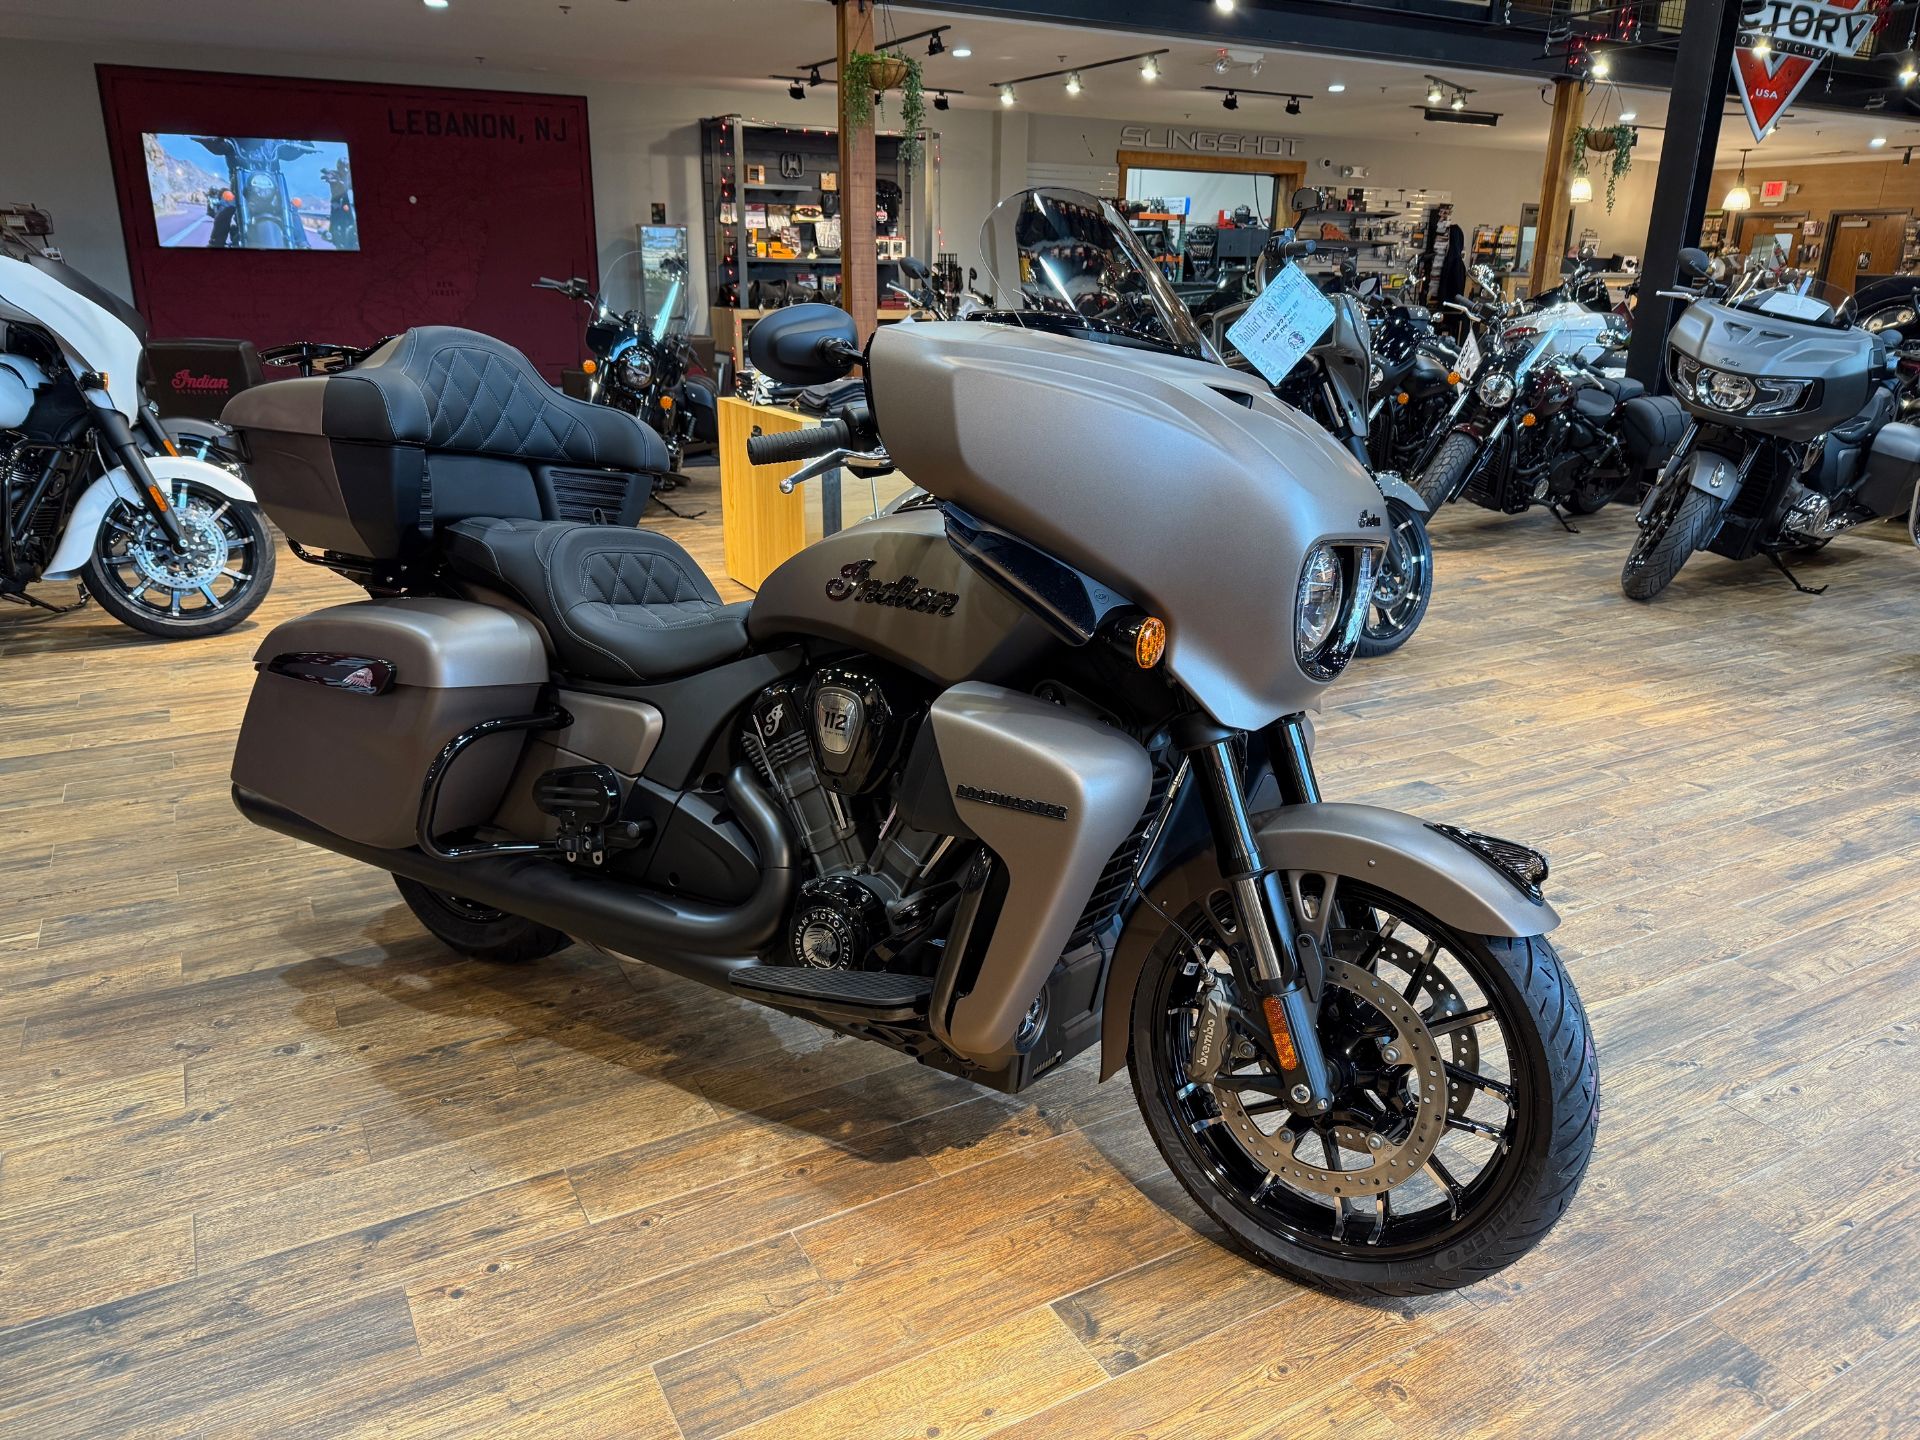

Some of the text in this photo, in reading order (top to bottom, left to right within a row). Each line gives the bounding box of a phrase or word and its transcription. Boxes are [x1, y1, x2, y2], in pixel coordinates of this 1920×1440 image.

[1740, 1, 1867, 48] CTORY
[1755, 88, 1778, 100] USA
[388, 108, 567, 144] LEBANON, NJ
[1120, 126, 1304, 157] SLINGSHOT
[1261, 325, 1277, 344] PLEASE
[171, 369, 229, 389] Indian
[825, 559, 960, 617] Indian
[824, 711, 848, 731] 112
[957, 784, 1068, 820] ROADMASTER
[795, 917, 809, 960] INDIAN
[1197, 1019, 1216, 1067] brembo
